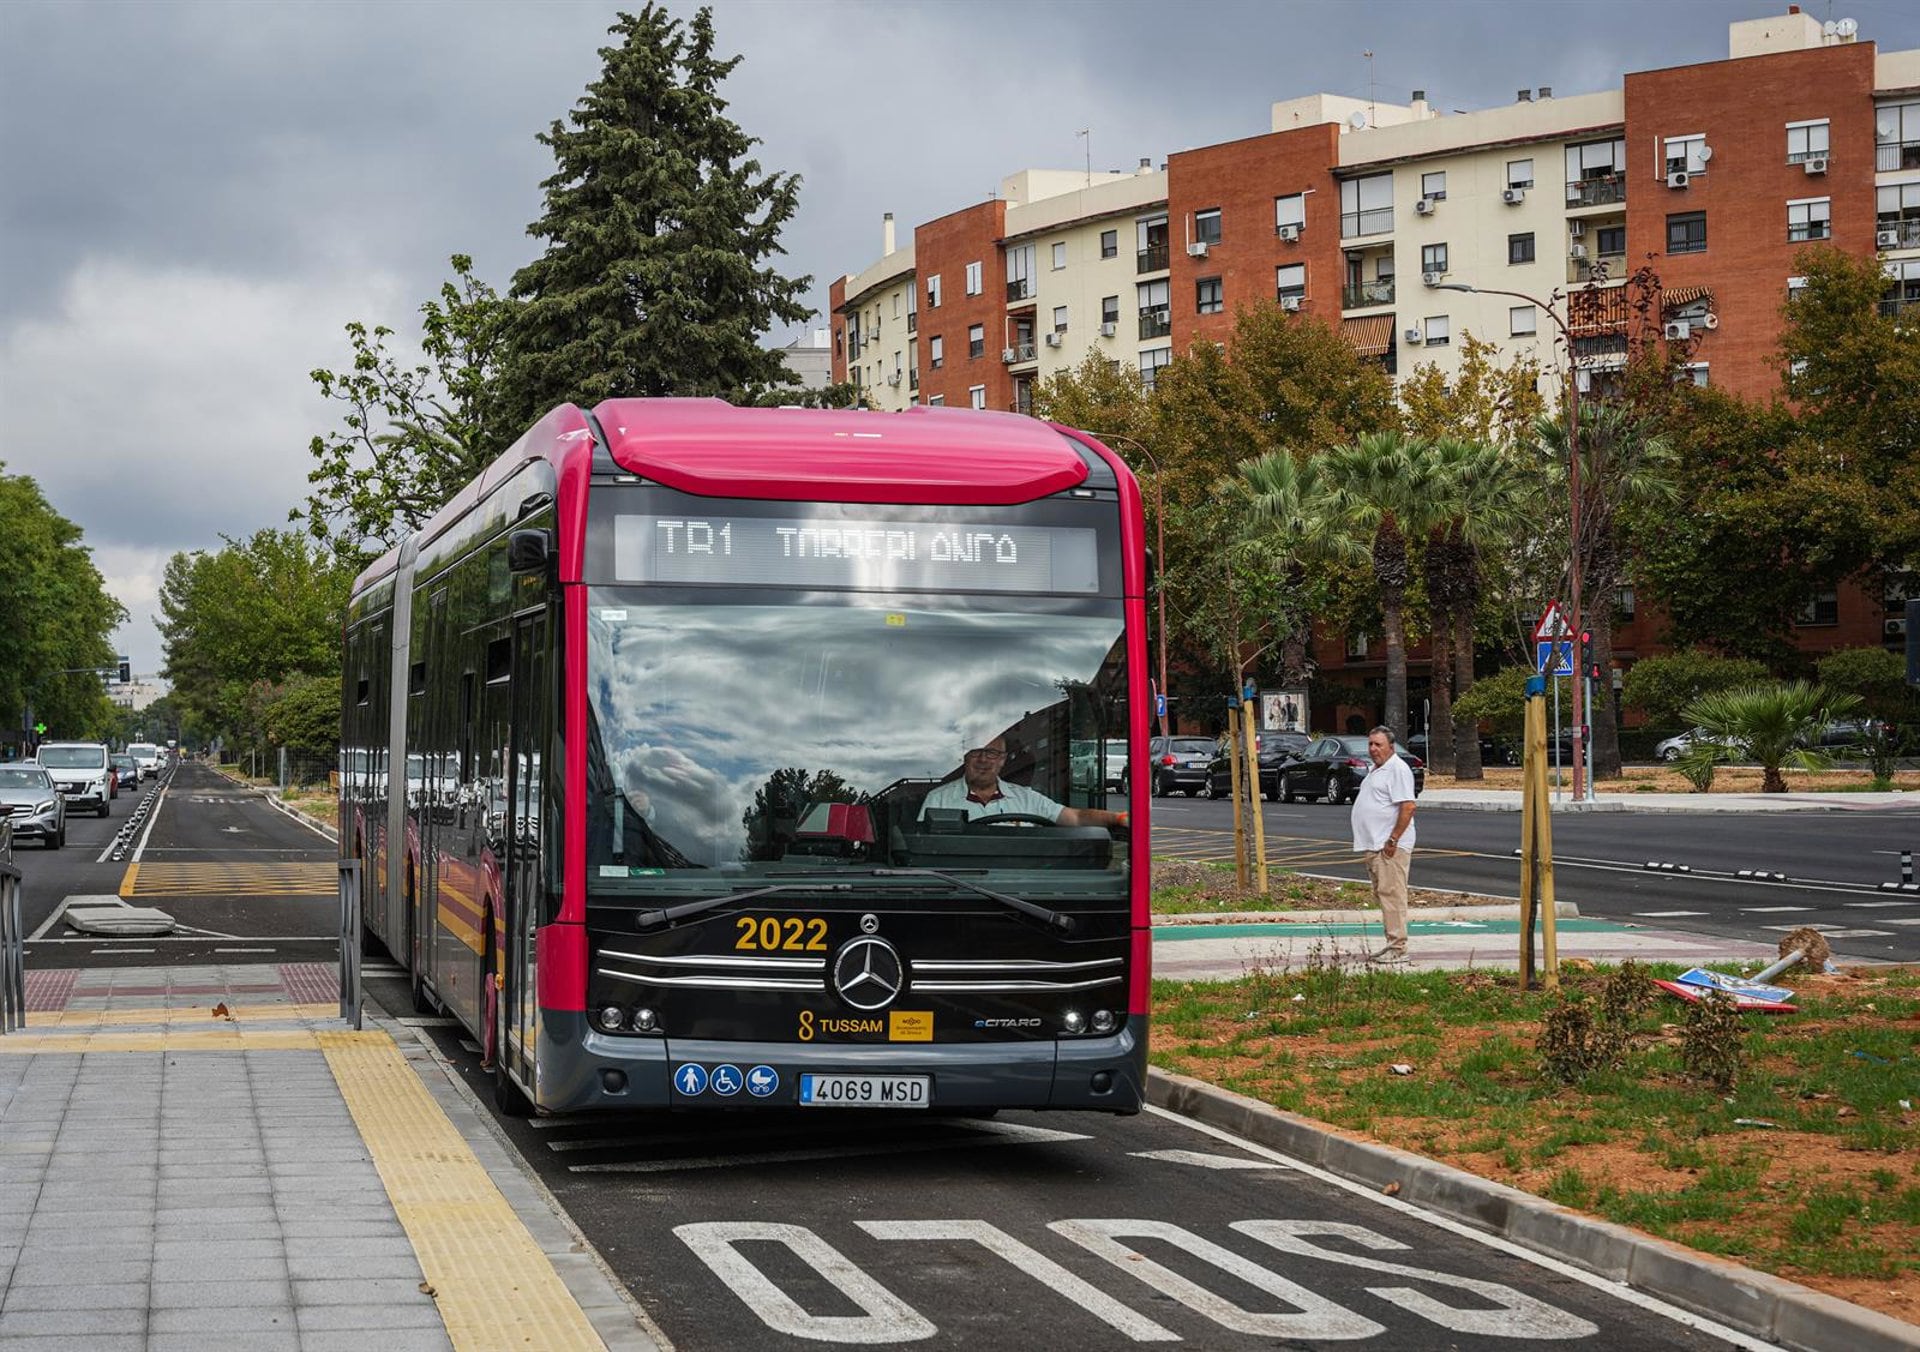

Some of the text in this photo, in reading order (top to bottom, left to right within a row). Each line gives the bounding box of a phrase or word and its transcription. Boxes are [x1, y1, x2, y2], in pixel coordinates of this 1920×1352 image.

[656, 520, 731, 555] TR1
[735, 917, 828, 951] 2022
[819, 1019, 884, 1033] TUSSAM
[816, 1080, 923, 1102] 4069 MSD
[672, 1218, 1600, 1345] SOLO
